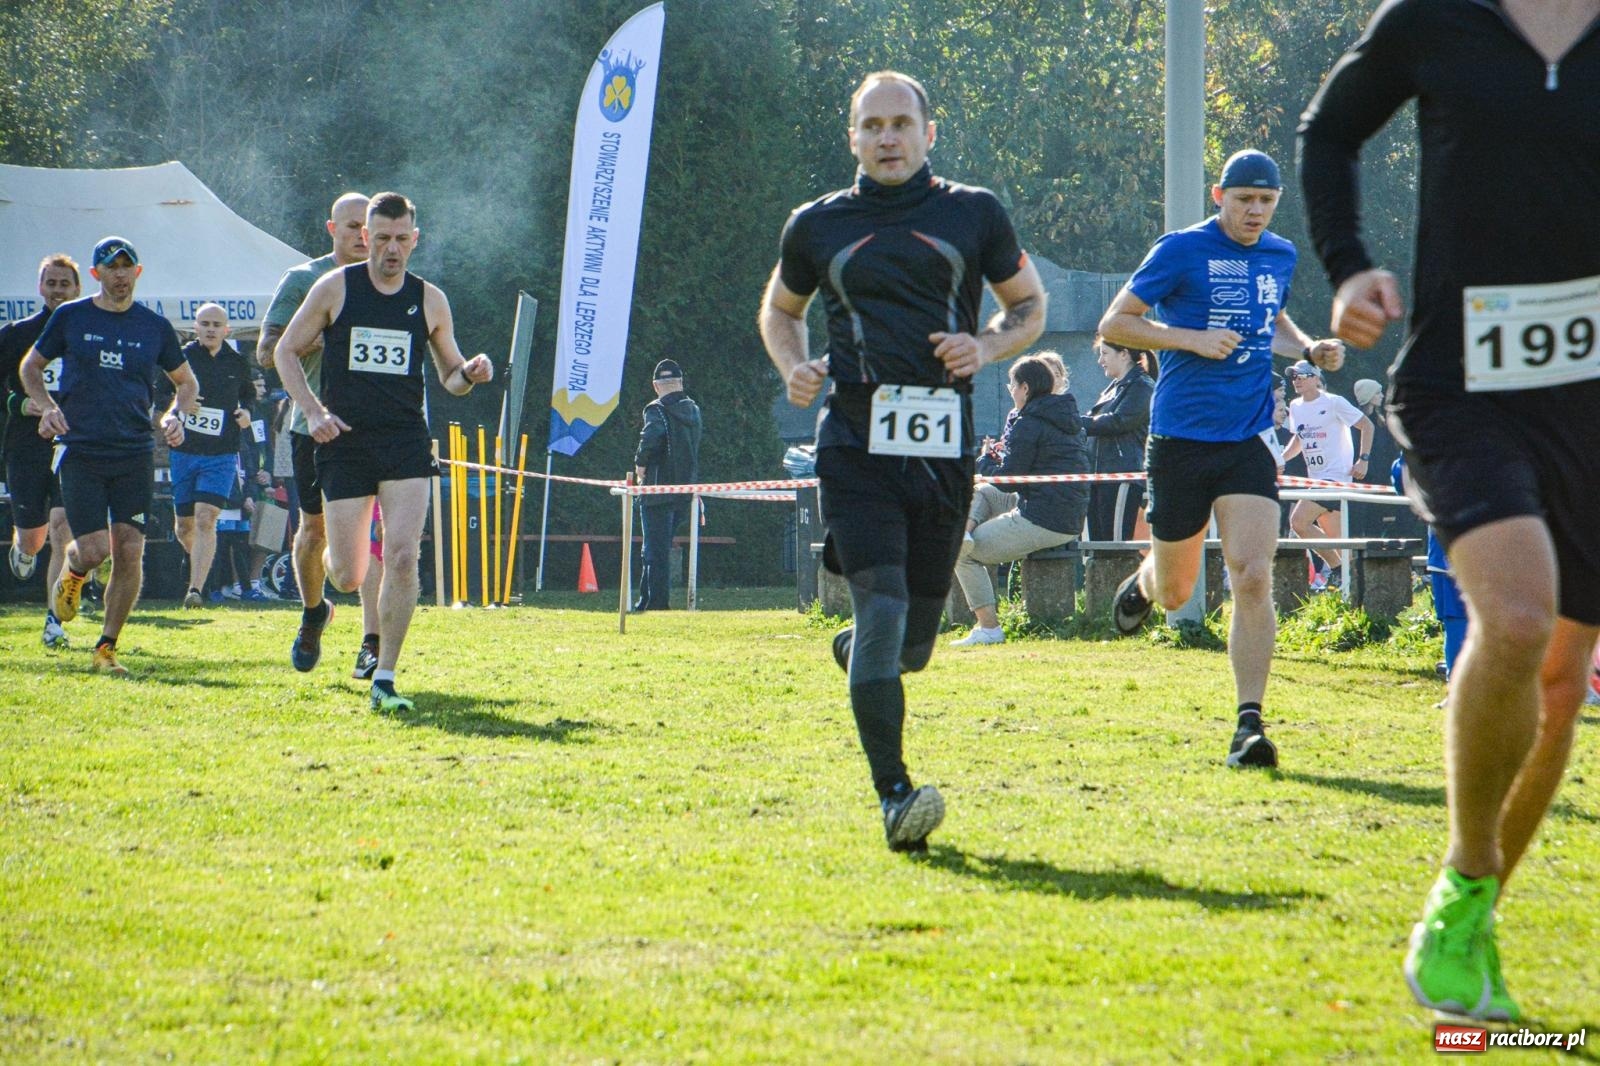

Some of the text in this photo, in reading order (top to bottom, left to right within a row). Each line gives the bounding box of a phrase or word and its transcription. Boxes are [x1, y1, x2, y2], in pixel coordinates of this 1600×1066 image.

[569, 132, 621, 392] STOWARZYSZENIE AKTYWNI DLA LEPSZEGO JUTRA
[180, 300, 256, 320] LEEGO
[354, 344, 406, 366] 333
[1477, 317, 1594, 369] 199
[188, 414, 220, 430] 329
[879, 411, 951, 443] 161
